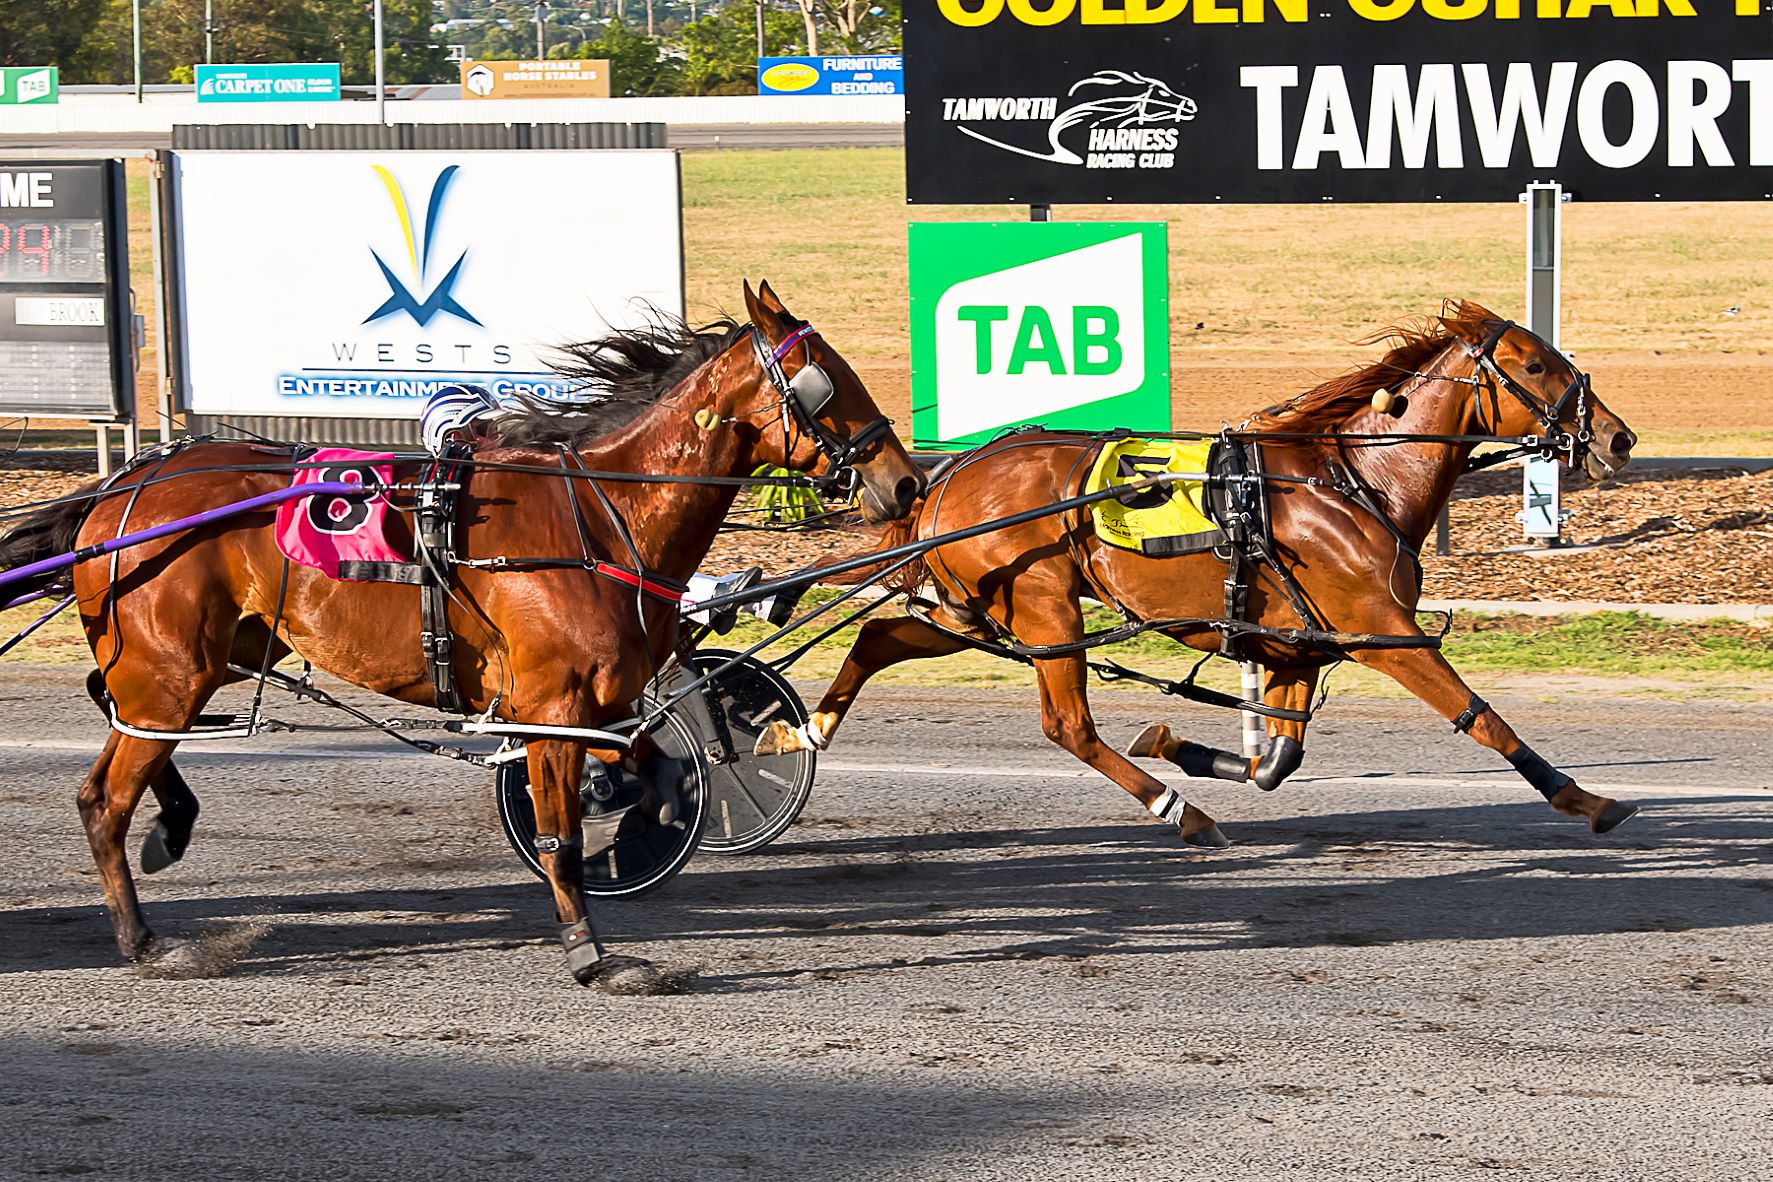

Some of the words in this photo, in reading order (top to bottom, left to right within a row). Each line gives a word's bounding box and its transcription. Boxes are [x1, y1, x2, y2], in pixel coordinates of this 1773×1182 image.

[518, 61, 582, 71] PORTABLE
[823, 57, 903, 71] FURNITURE
[503, 72, 543, 81] HORSE
[545, 71, 597, 80] STABLES
[852, 72, 874, 81] AND
[22, 81, 46, 92] TAB
[215, 79, 273, 94] CARPET
[273, 78, 307, 93] ONE
[831, 82, 896, 94] BEDDING
[942, 97, 1059, 121] TAMWORTH
[1087, 127, 1180, 151] HARNESS
[1085, 153, 1137, 169] RACING
[1138, 153, 1176, 169] CLUB
[957, 305, 1123, 376] TAB
[332, 343, 512, 364] WESTS
[306, 464, 384, 535] 8
